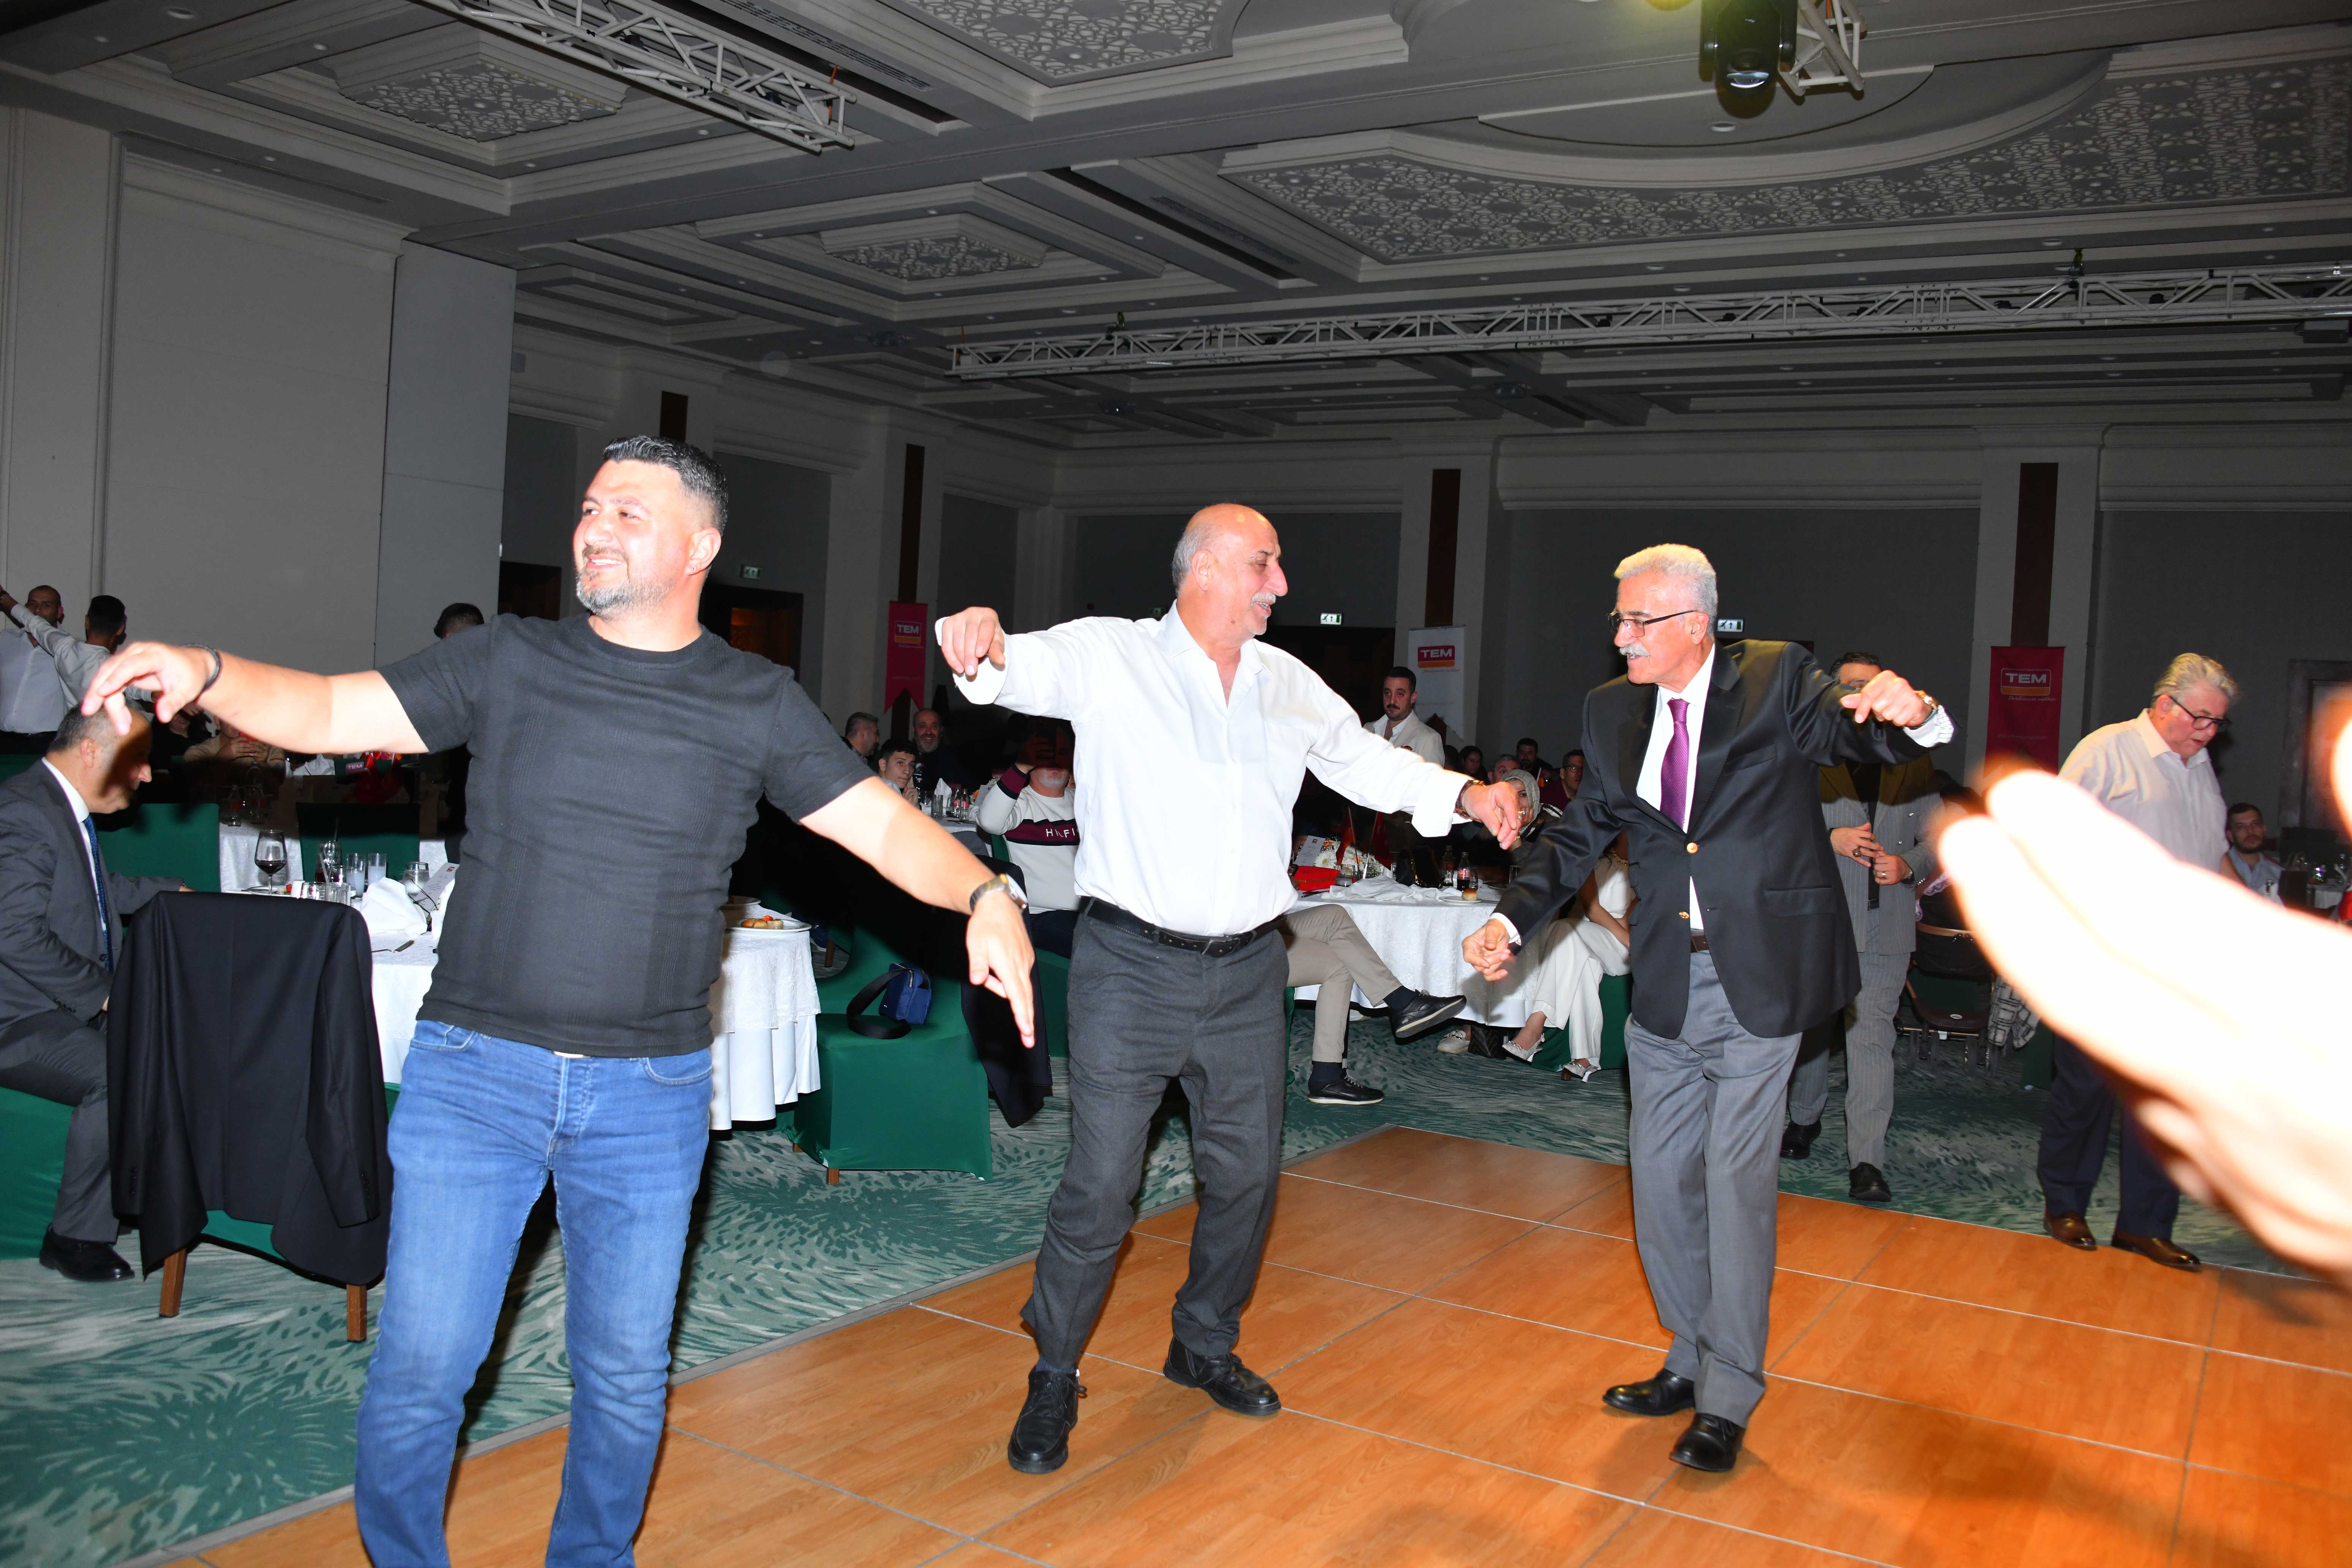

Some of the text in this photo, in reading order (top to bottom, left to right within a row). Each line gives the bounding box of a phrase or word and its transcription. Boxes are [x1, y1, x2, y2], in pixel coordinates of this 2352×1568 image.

[897, 624, 919, 634] TEM
[1421, 648, 1452, 658] TEM
[2005, 673, 2047, 683] TEM
[1046, 828, 1079, 838] HILFI
